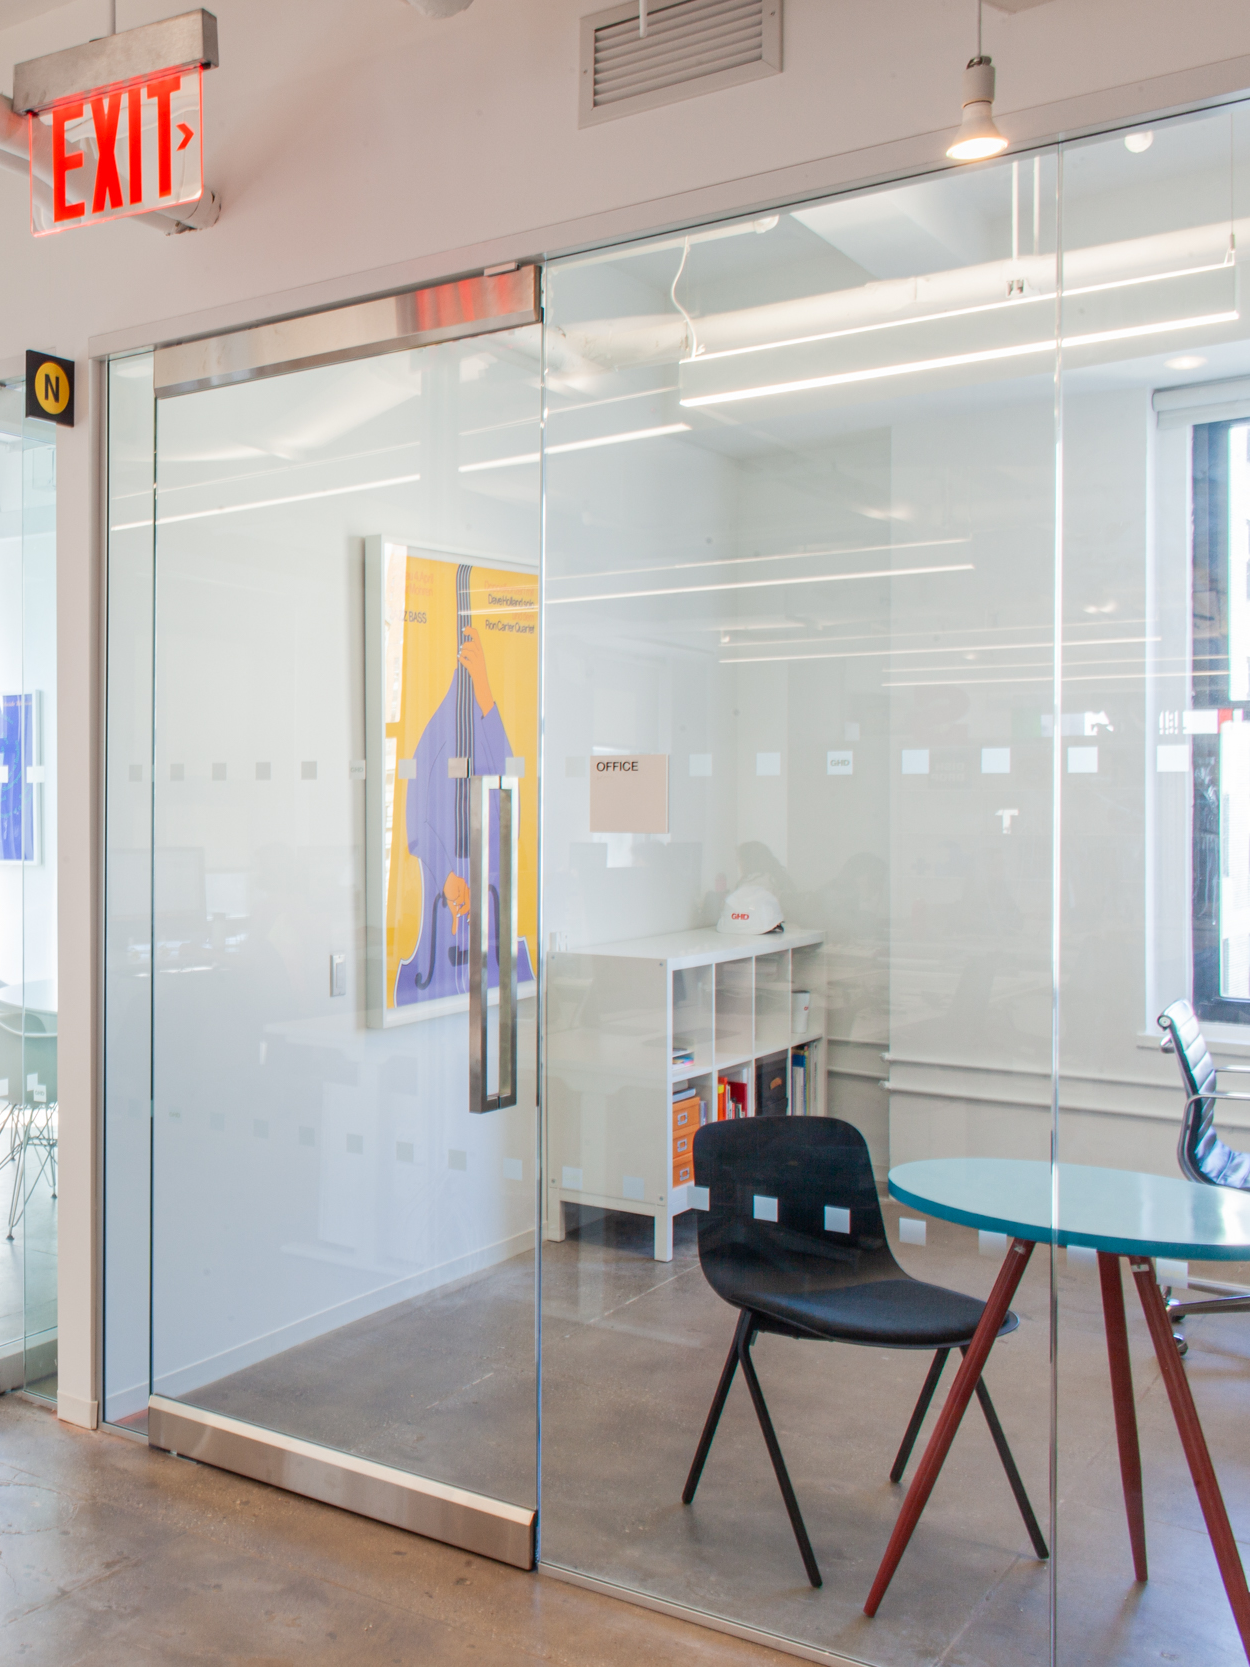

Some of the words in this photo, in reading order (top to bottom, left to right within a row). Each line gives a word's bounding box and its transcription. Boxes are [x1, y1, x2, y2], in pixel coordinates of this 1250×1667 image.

[52, 75, 181, 223] EXIT
[44, 373, 60, 404] N
[488, 594, 502, 605] Dave
[502, 595, 523, 607] Holland
[409, 611, 427, 624] BASS
[485, 619, 496, 631] Ron
[497, 620, 515, 632] Carter
[596, 761, 639, 772] OFFICE
[830, 759, 850, 767] GHD
[731, 912, 750, 921] GHD
